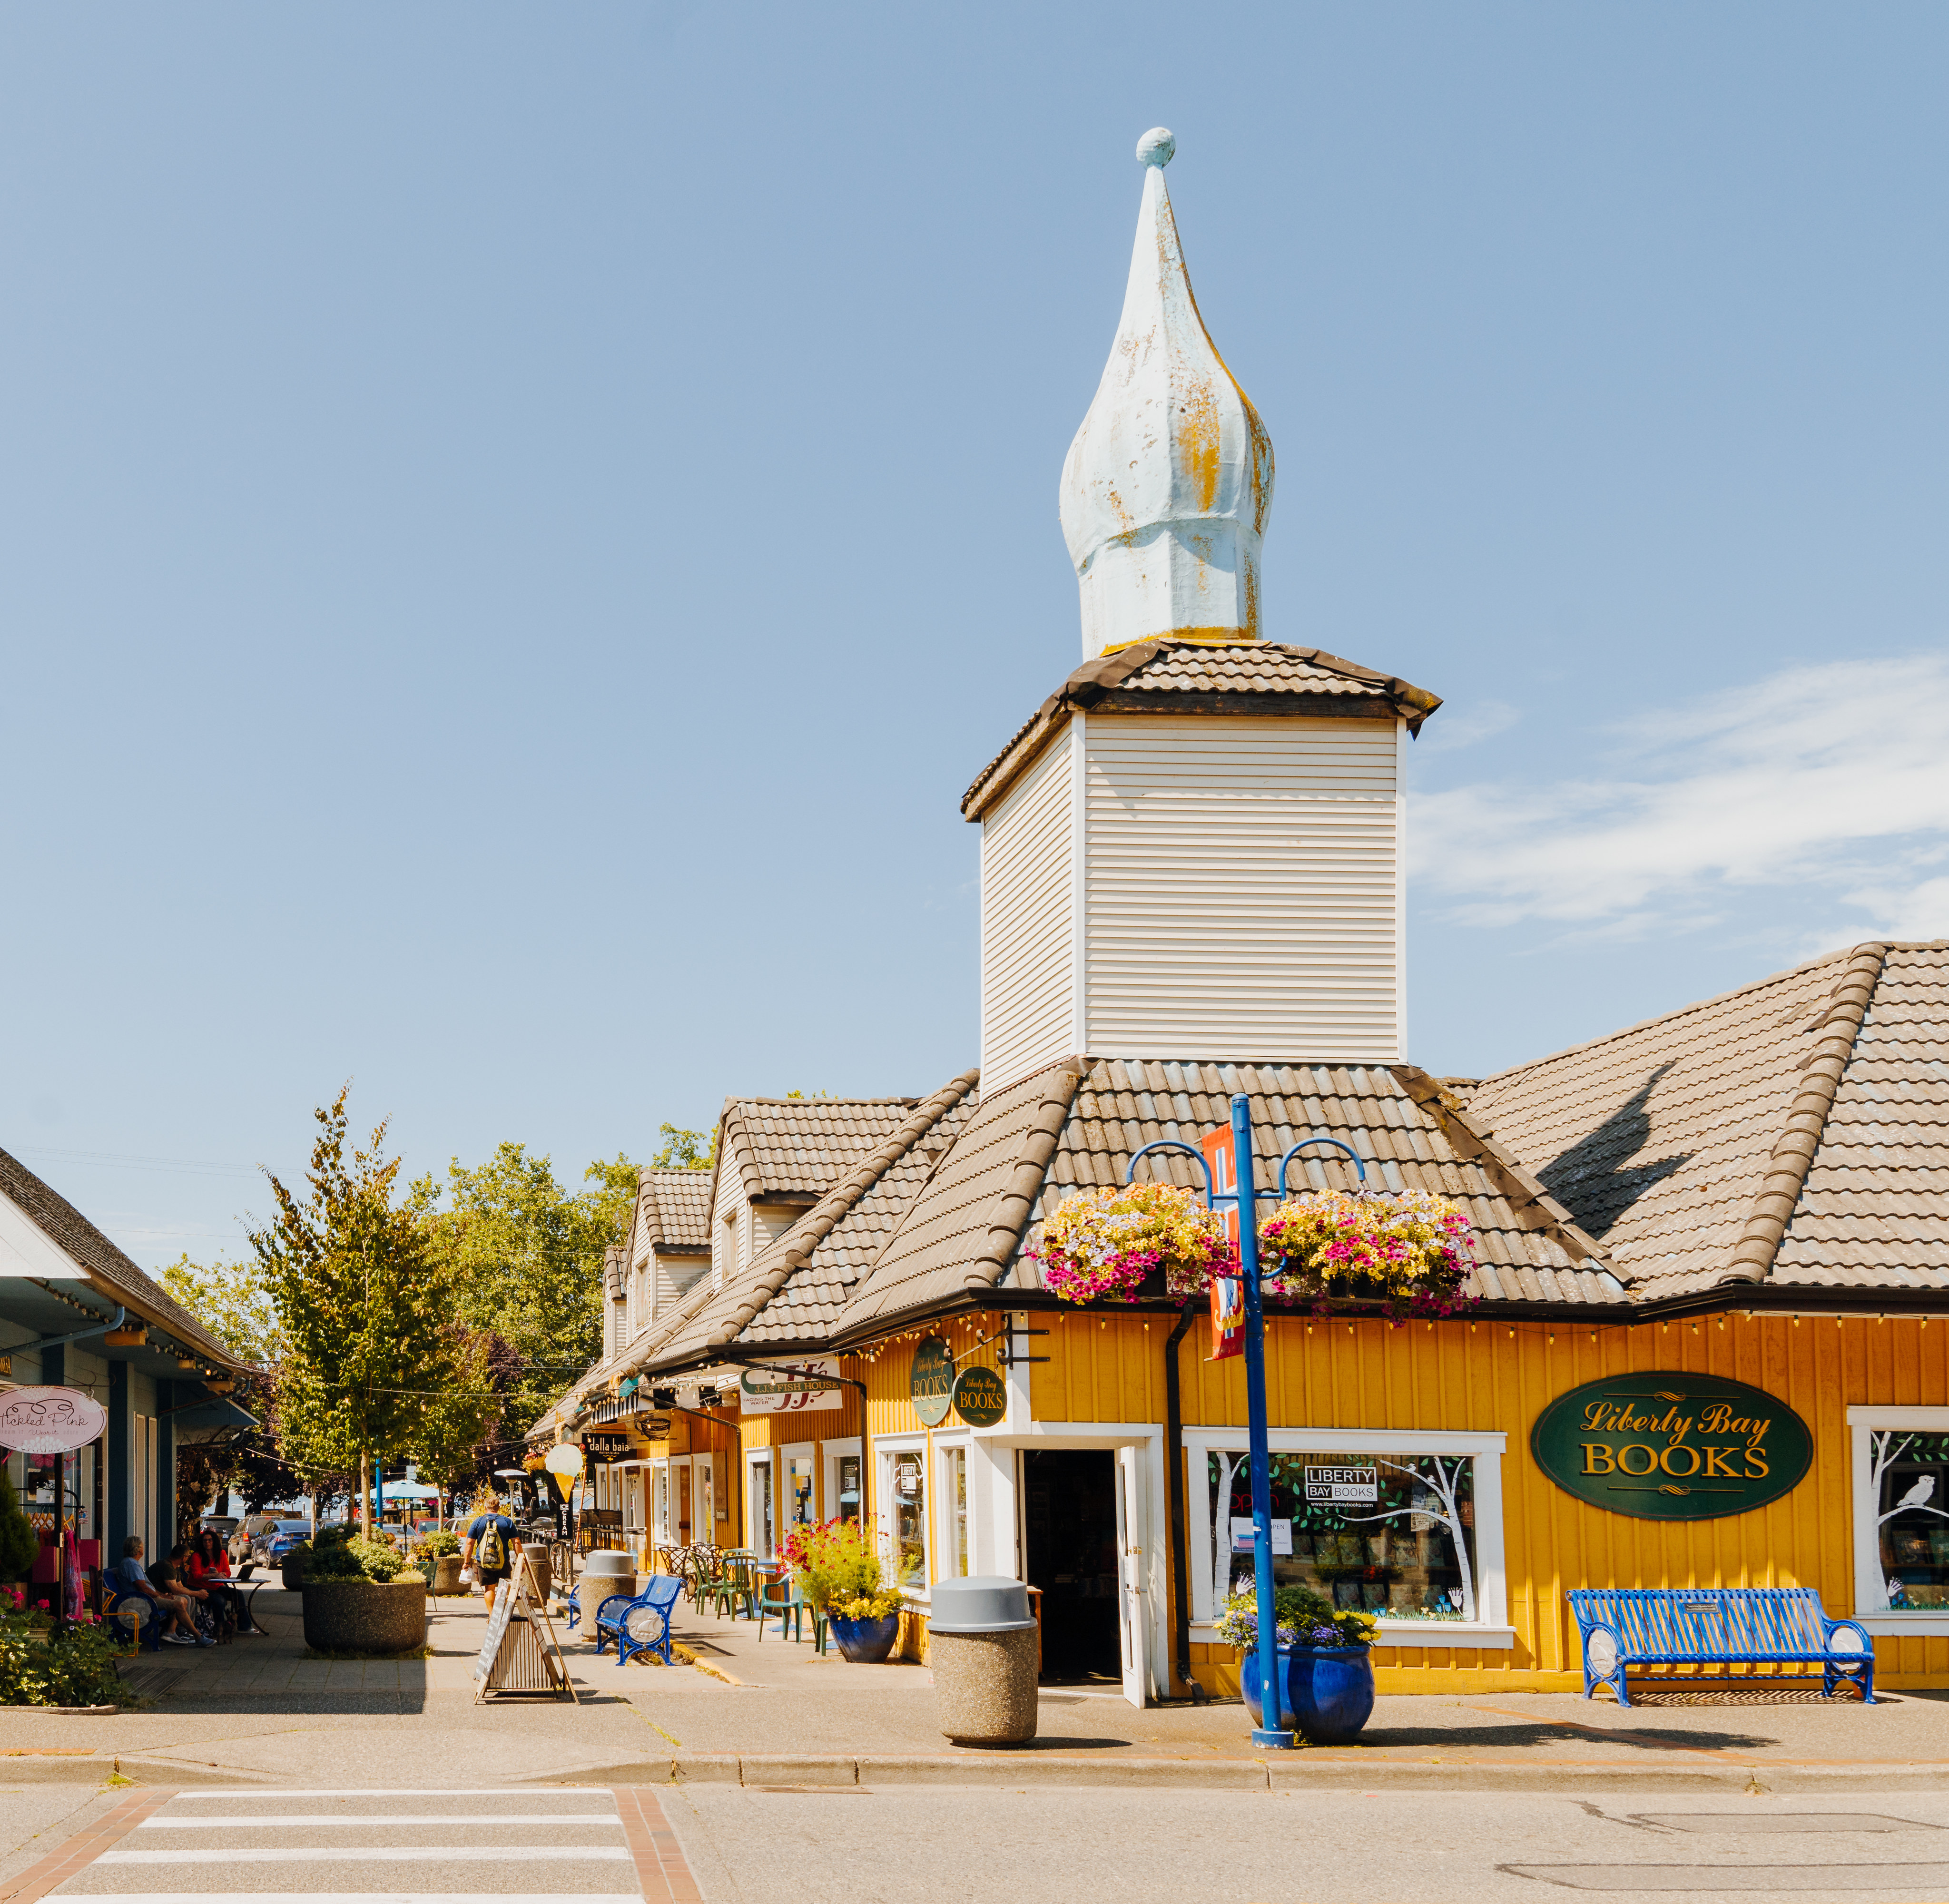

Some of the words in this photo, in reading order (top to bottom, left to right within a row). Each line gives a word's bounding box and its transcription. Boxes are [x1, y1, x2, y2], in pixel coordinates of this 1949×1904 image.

[917, 1356, 932, 1376] Liberty
[933, 1354, 945, 1375] Bay
[777, 1383, 801, 1392] FISH
[804, 1381, 838, 1390] HOUSE
[914, 1374, 948, 1402] BOOKS
[965, 1377, 983, 1392] Liberty
[984, 1378, 997, 1393] Bay
[959, 1392, 1003, 1409] BOOKS
[48, 1412, 88, 1426] Pink
[1580, 1401, 1693, 1445] Liberty
[1697, 1404, 1771, 1447] Bay
[590, 1437, 609, 1451] dalla
[613, 1438, 629, 1451] baia
[1580, 1443, 1770, 1479] BOOKS
[902, 1466, 915, 1475] LIBERTY
[1310, 1470, 1372, 1482] LIBERTY
[1310, 1487, 1330, 1496] BAY
[1335, 1488, 1373, 1497] BOOKS
